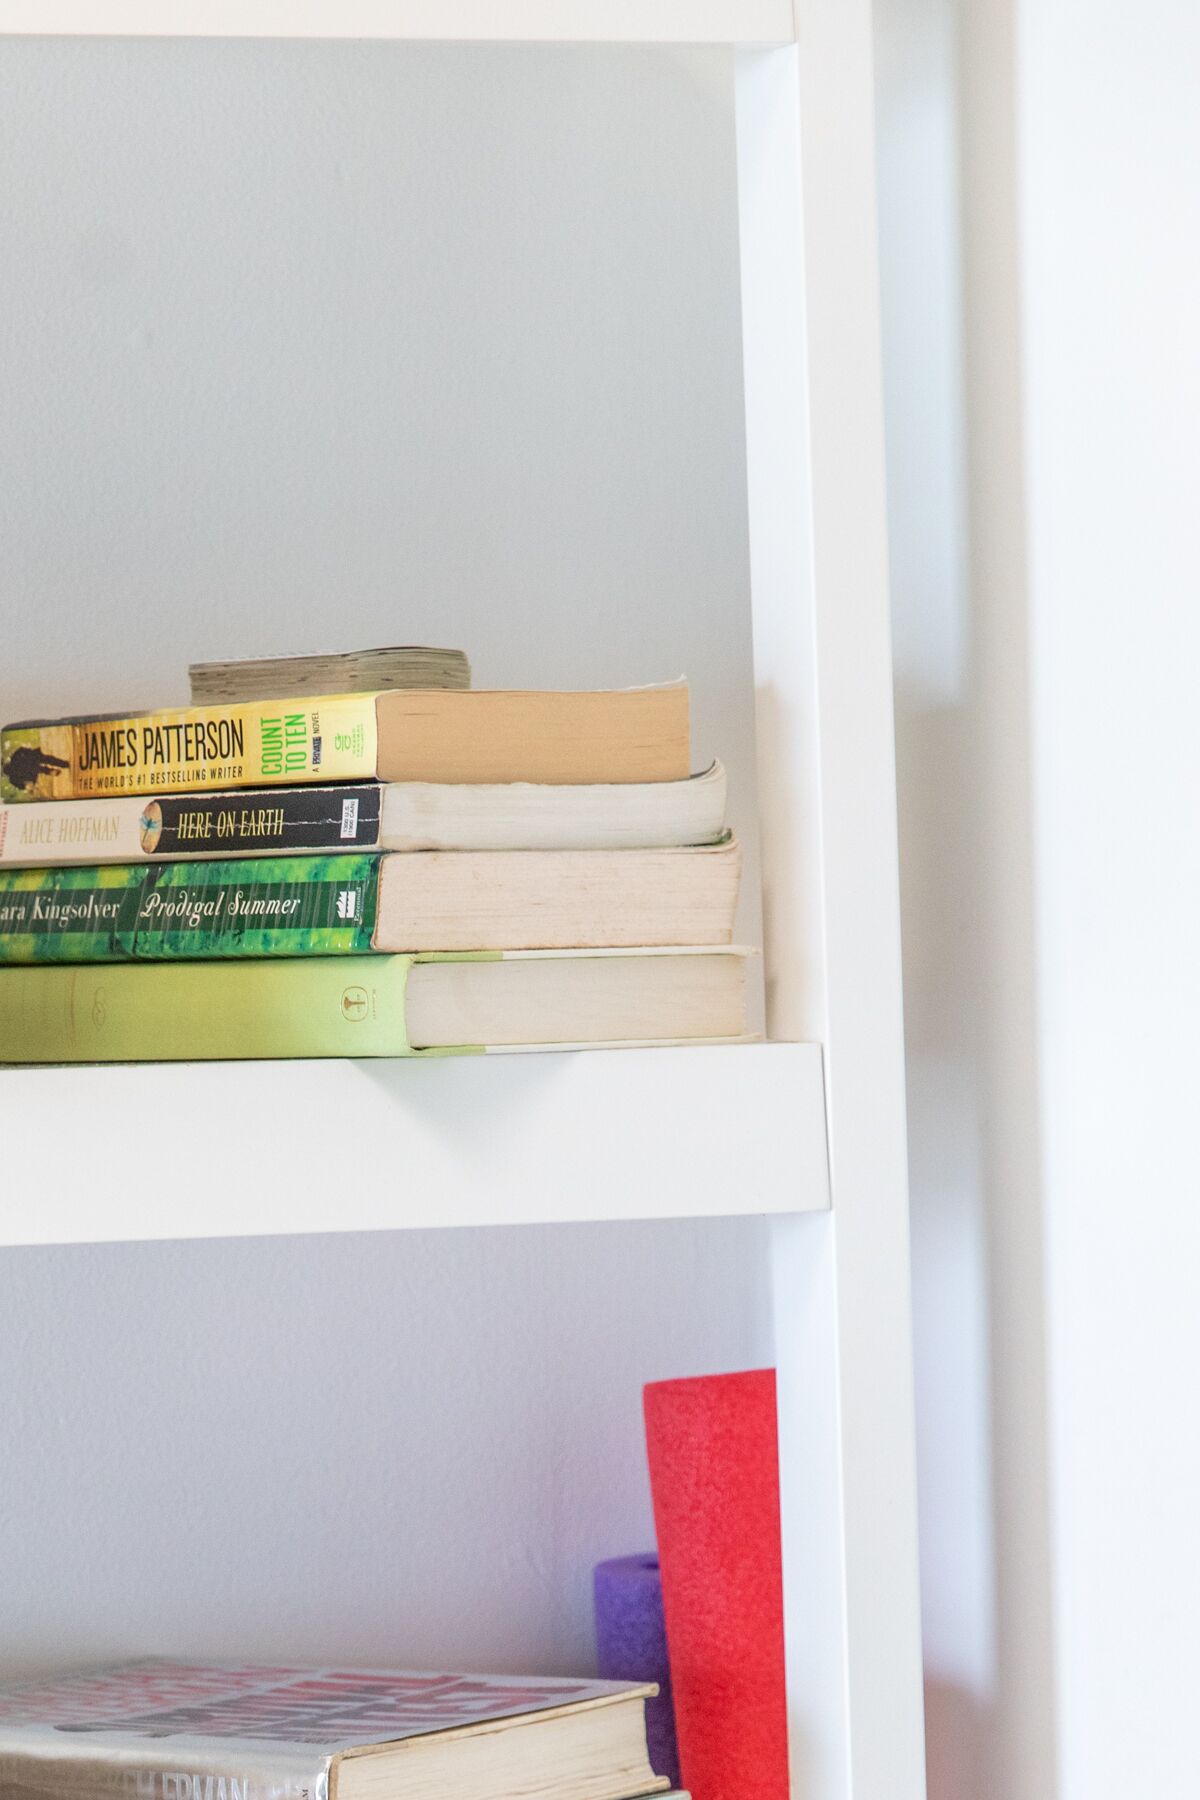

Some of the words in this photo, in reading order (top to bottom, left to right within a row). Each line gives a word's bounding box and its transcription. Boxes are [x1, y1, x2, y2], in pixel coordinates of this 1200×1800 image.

[284, 713, 307, 748] TEN
[311, 711, 320, 735] NOVEL
[79, 728, 138, 771] JAMES
[143, 718, 244, 765] PATTERSON
[261, 717, 283, 775] COUNT
[312, 735, 322, 765] PRIVATE
[79, 777, 94, 790] THE
[97, 775, 134, 789] WORLD'S
[137, 773, 147, 786] #1
[150, 769, 206, 784] BESTSELLING
[210, 766, 244, 779] WRITER
[285, 751, 307, 774] TO
[19, 818, 53, 844] ALICE
[58, 815, 120, 843] HOFFMAN
[177, 811, 213, 839] HERE
[216, 810, 236, 838] ON
[240, 808, 284, 837] EARTH
[32, 894, 120, 928] Kingsolver
[140, 890, 225, 927] Prodigal
[228, 890, 300, 916] Summer
